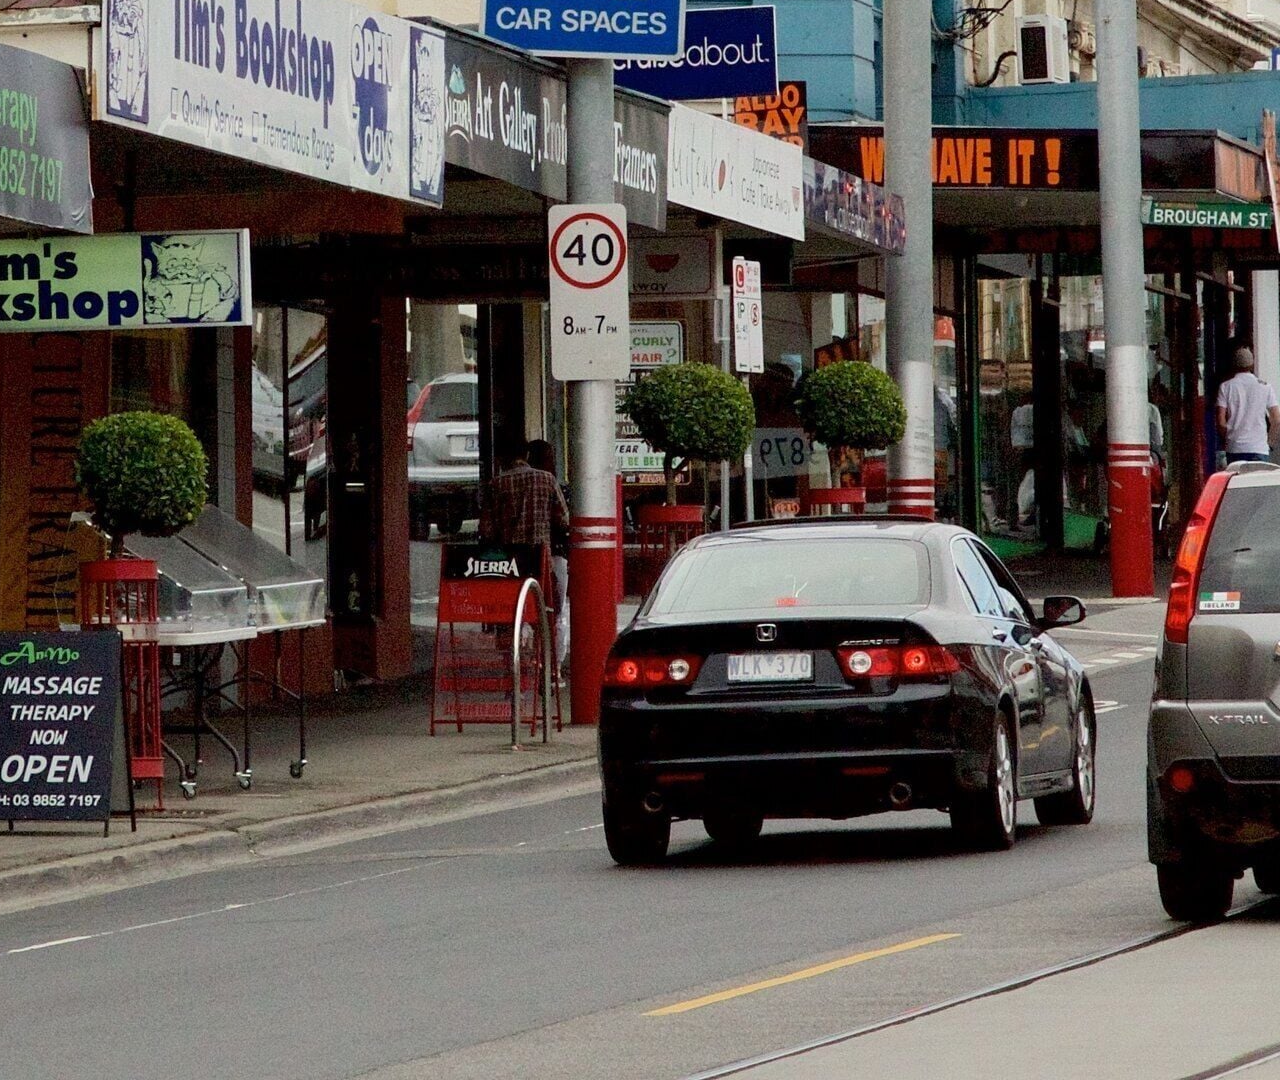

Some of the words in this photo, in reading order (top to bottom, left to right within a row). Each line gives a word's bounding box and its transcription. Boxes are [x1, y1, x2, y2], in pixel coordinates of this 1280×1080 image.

[495, 6, 551, 31] CAR
[561, 9, 667, 35] SPACES
[351, 23, 393, 92] OPEN
[445, 86, 474, 141] SIERRA
[475, 72, 494, 141] Art
[181, 90, 213, 138] Quality
[214, 99, 244, 139] Service
[262, 112, 310, 158] Tremendous
[311, 127, 335, 170] Range
[364, 106, 393, 184] days
[613, 120, 658, 194] Framers
[861, 137, 885, 183] W
[1008, 139, 1035, 185] IT
[29, 153, 64, 204] 7197
[1153, 206, 1242, 228] BROUGHAM
[1247, 210, 1269, 229] ST
[563, 232, 614, 267] 40
[632, 337, 674, 347] CURLY
[631, 353, 663, 363] HAIR
[463, 556, 520, 578] SIERRA
[2, 676, 102, 695] MASSAGE
[10, 705, 95, 721] THERAPY
[1209, 715, 1269, 724] X-TRAIL
[29, 729, 68, 745] NOW
[0, 754, 94, 783] OPEN
[12, 795, 30, 807] 03
[32, 794, 68, 807] 9852
[69, 795, 101, 806] 7197
